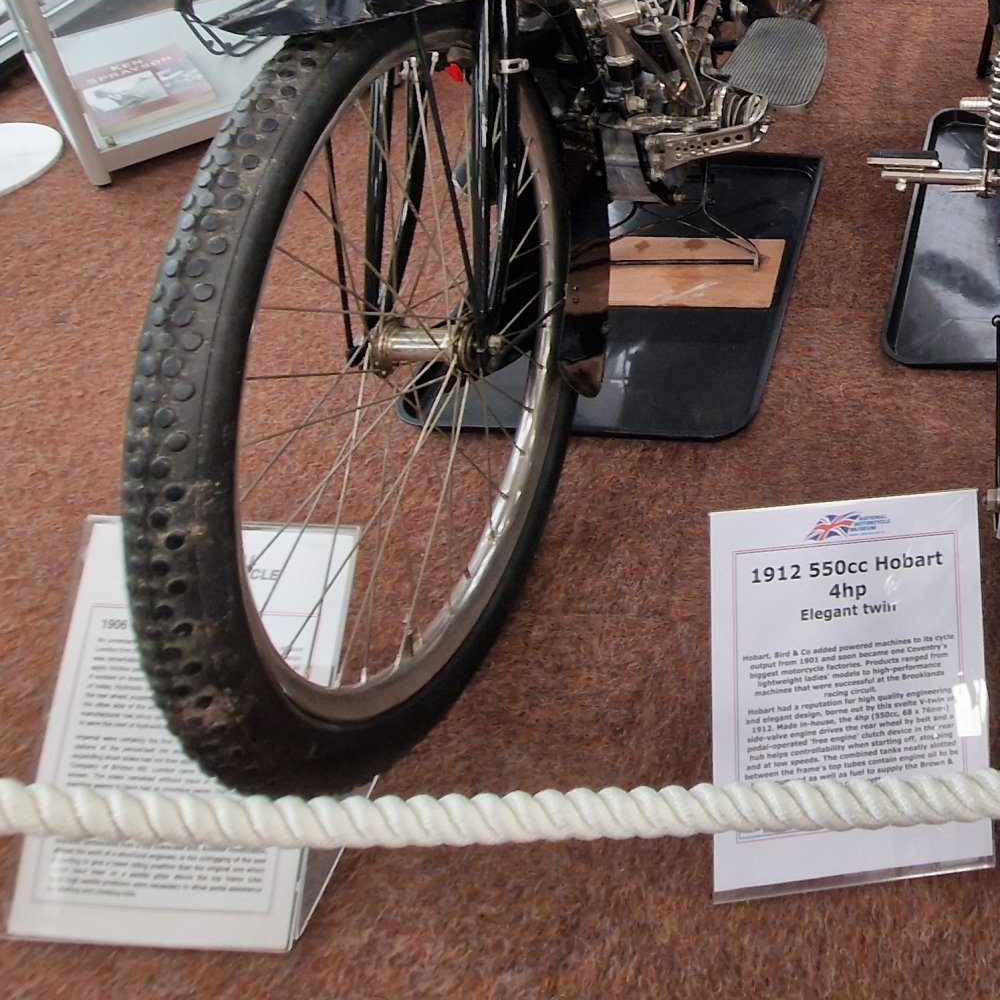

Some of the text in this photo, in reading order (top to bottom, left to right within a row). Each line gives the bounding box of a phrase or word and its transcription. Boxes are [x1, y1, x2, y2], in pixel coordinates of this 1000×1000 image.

[110, 58, 143, 71] KEN
[752, 551, 943, 583] 1912 550cc Hobart
[829, 583, 867, 600] 4hp
[801, 604, 858, 621] Elegant
[102, 618, 128, 630] 1906
[774, 650, 790, 658] Bird
[813, 645, 837, 654] added
[839, 641, 873, 654] powered
[875, 638, 912, 648] machines
[935, 632, 956, 642] cycle
[750, 669, 779, 680] biggest
[781, 664, 824, 676] motorcycle
[865, 656, 900, 666] Products
[901, 652, 929, 663] ranged
[751, 660, 776, 671] output
[800, 656, 819, 665] 1901
[822, 654, 836, 662] and
[859, 650, 889, 658] became
[755, 687, 792, 697] machines
[794, 684, 810, 692] that
[835, 676, 875, 688] successful
[877, 675, 885, 683] at
[887, 674, 900, 682] the
[902, 669, 944, 680] Brooklands
[758, 675, 802, 689] lightweight
[832, 669, 860, 679] models
[872, 662, 941, 676] high-performance
[824, 690, 849, 698] racing
